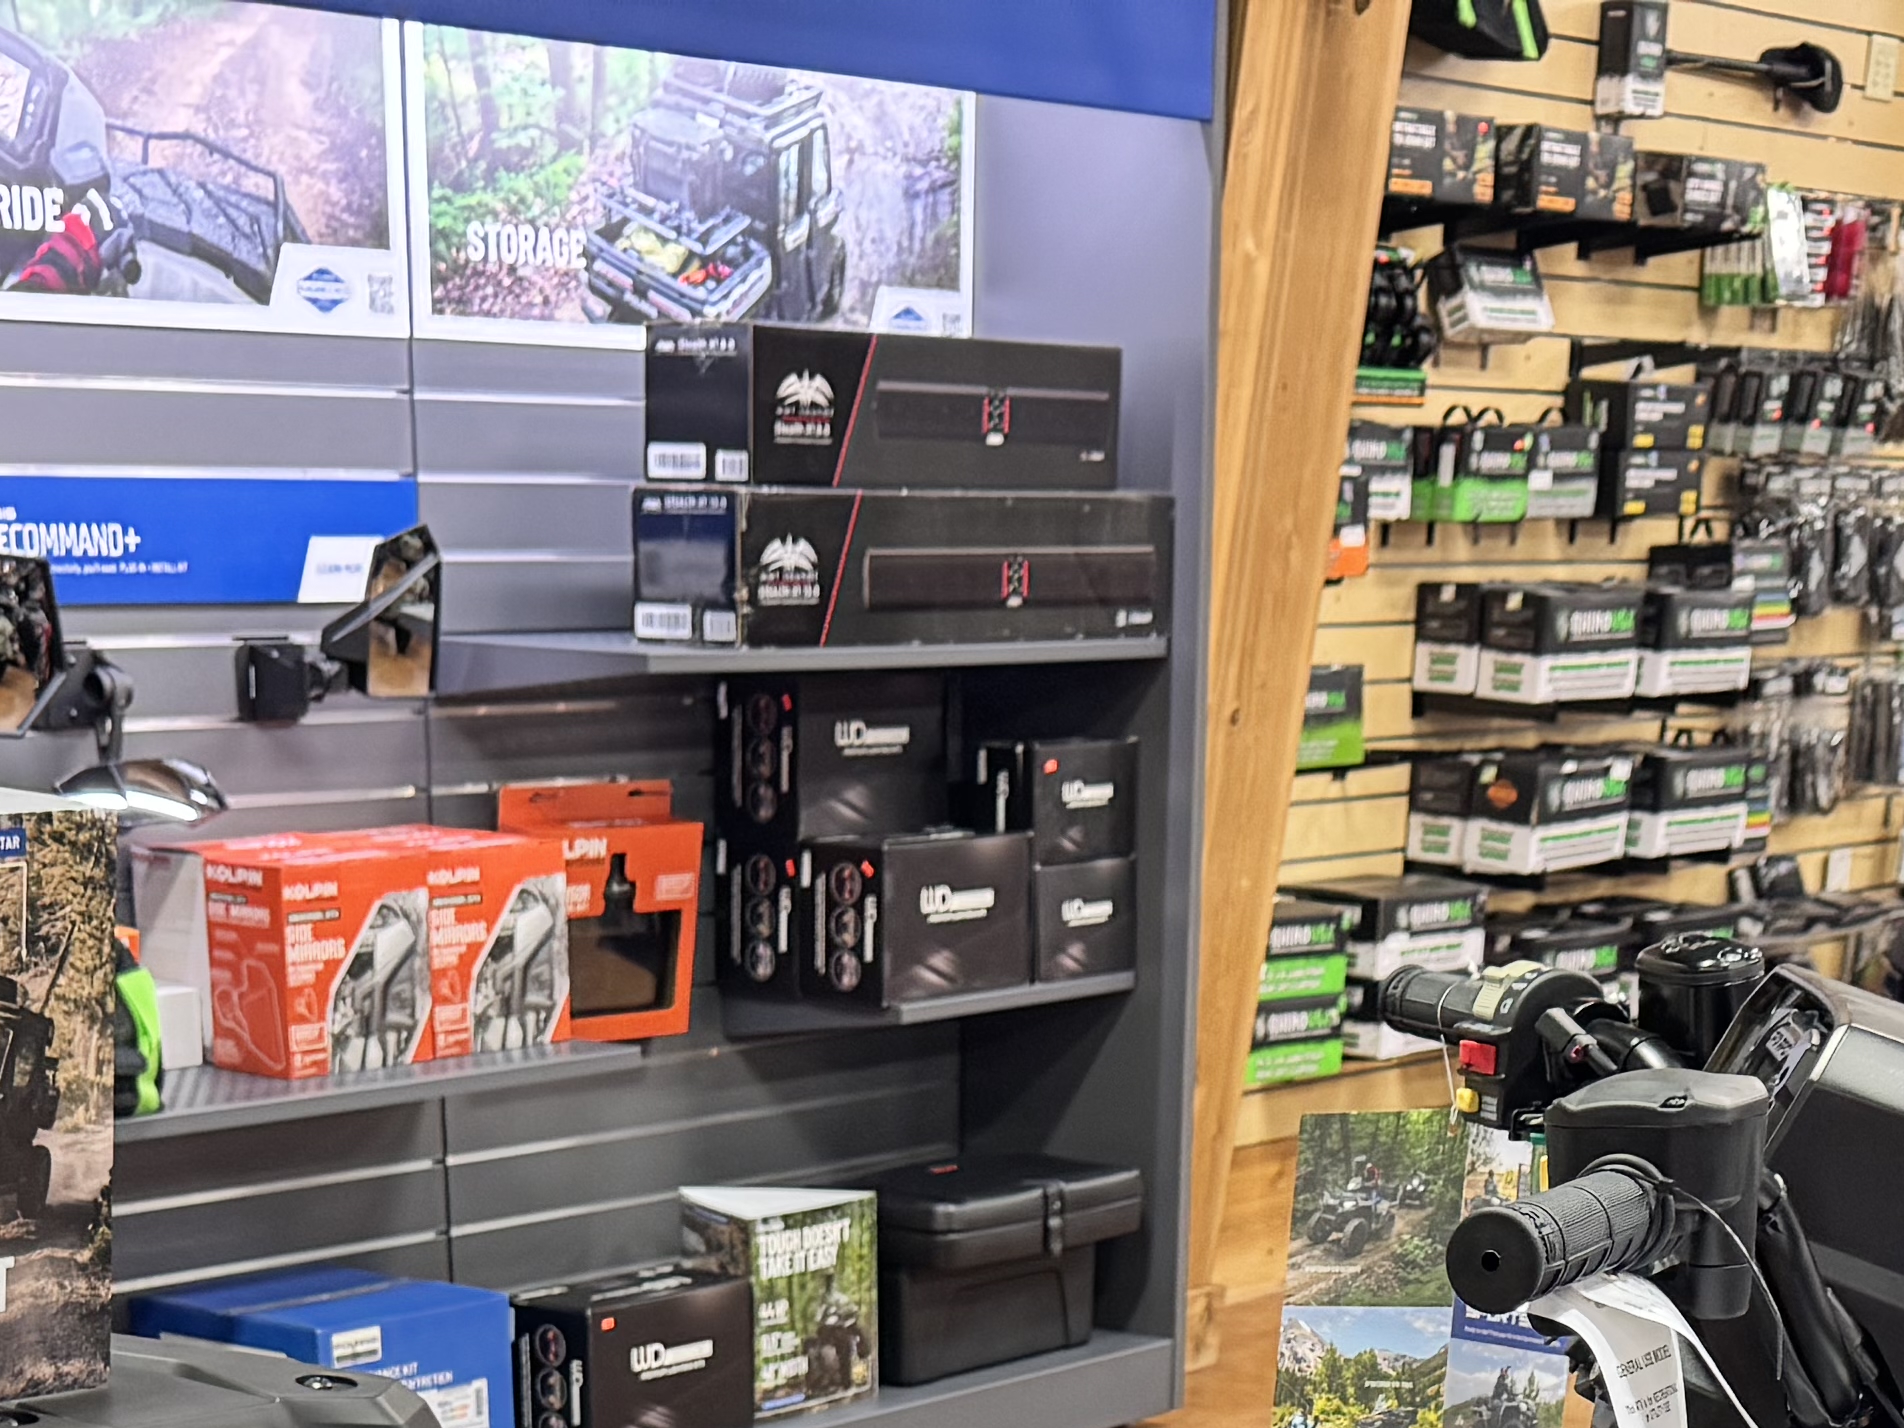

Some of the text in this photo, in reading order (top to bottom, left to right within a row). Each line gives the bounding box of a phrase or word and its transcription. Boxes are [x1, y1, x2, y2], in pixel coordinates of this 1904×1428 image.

[466, 222, 588, 270] STORAGE
[562, 837, 607, 860] LPIN
[206, 864, 264, 888] KOLPIN
[427, 867, 481, 887] KOLPIN
[283, 882, 339, 901] KOLPIN
[758, 1217, 851, 1256] TOUGH DOESN'T
[759, 1244, 840, 1281] TAKE IT EASY
